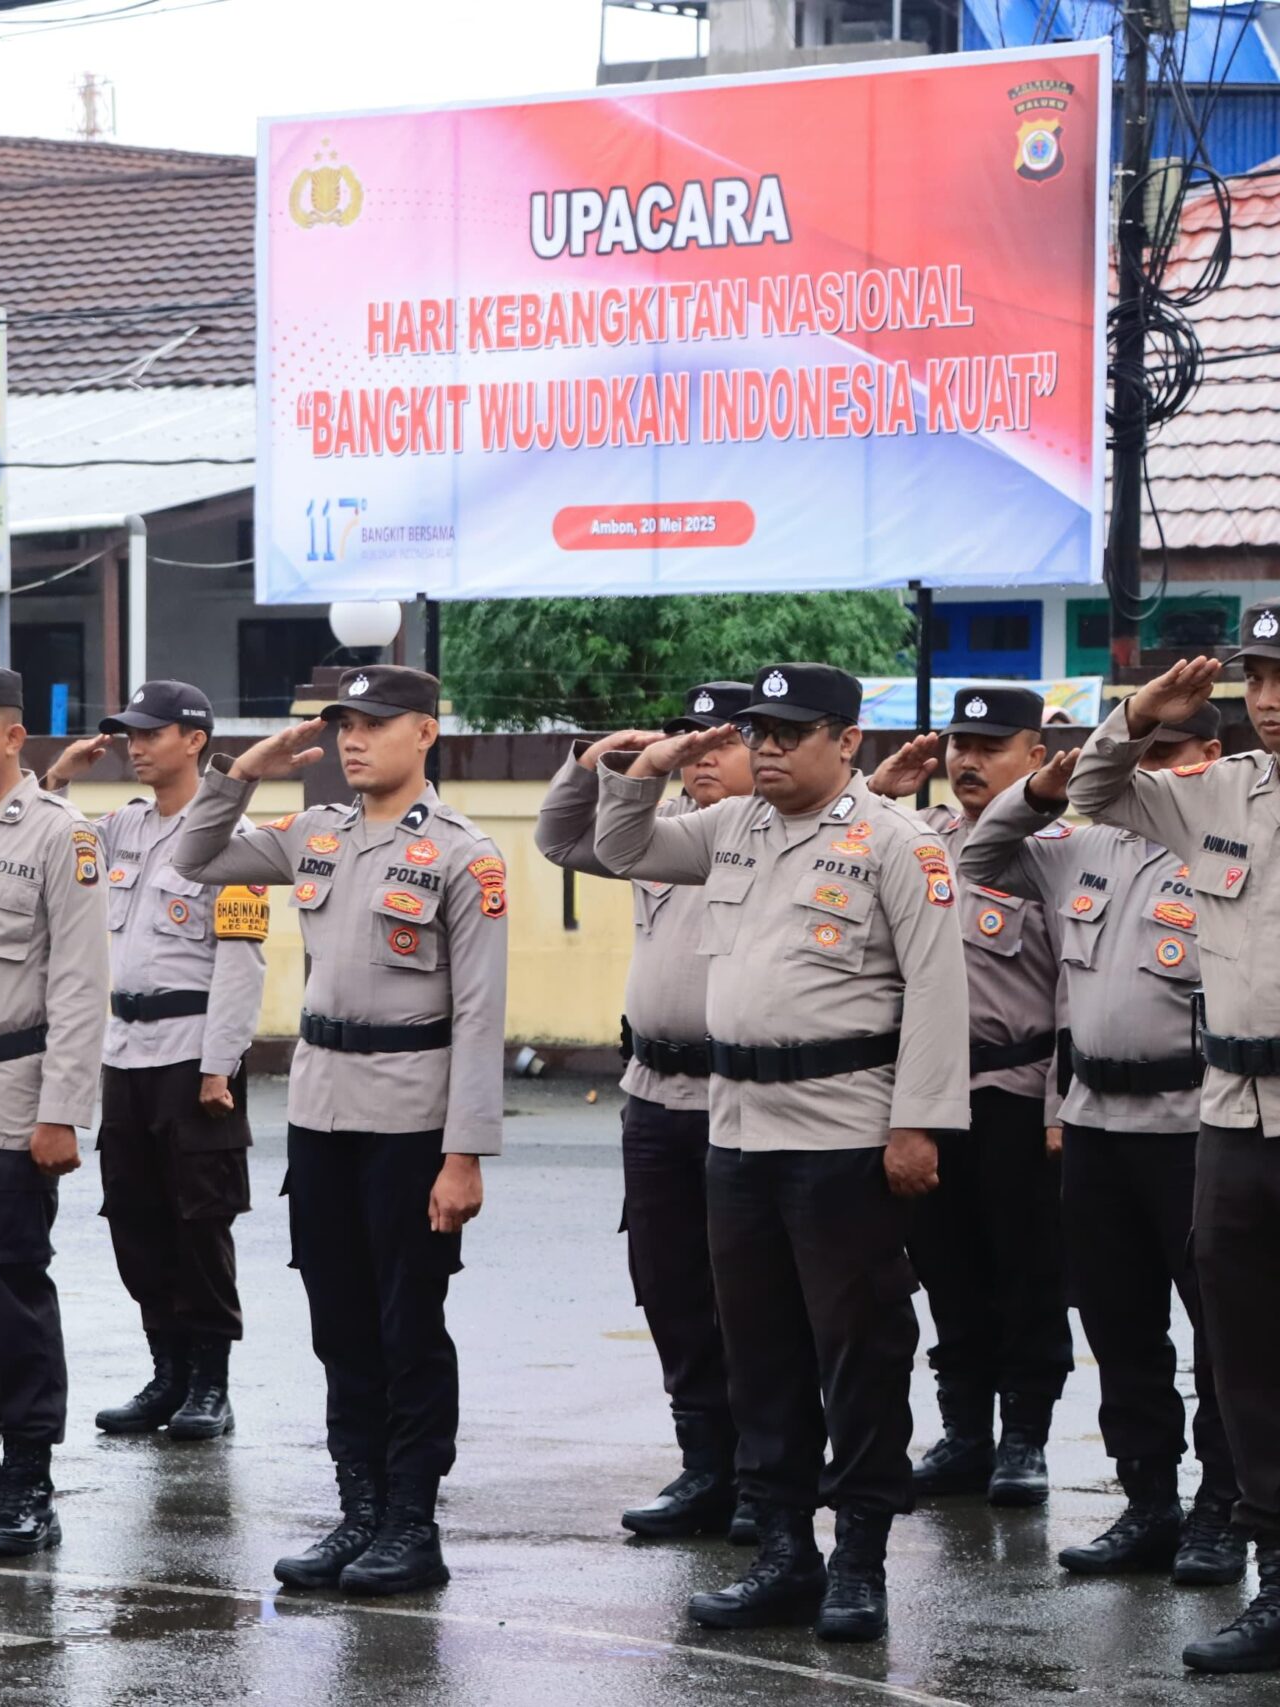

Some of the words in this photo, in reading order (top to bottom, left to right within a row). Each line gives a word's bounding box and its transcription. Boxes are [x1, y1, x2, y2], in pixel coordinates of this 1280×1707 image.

[1016, 99, 1065, 114] MALUKU
[530, 174, 792, 260] UPACARA
[367, 298, 457, 357] HARI
[467, 277, 748, 352] KEBANGKITAN
[759, 264, 974, 337] NASIONAL
[477, 371, 691, 454] WUJUDKAN
[701, 359, 916, 443] INDONESIA
[361, 526, 405, 543] BANGKIT
[408, 525, 456, 542] BERSAMA
[591, 518, 638, 536] Ambon,
[640, 518, 657, 534] 20
[659, 517, 683, 533] Mei
[685, 516, 716, 532] 2025
[297, 856, 337, 878] AZMIN
[812, 858, 871, 883] POLRI
[384, 866, 442, 892] POLRI
[1160, 880, 1194, 898] POL
